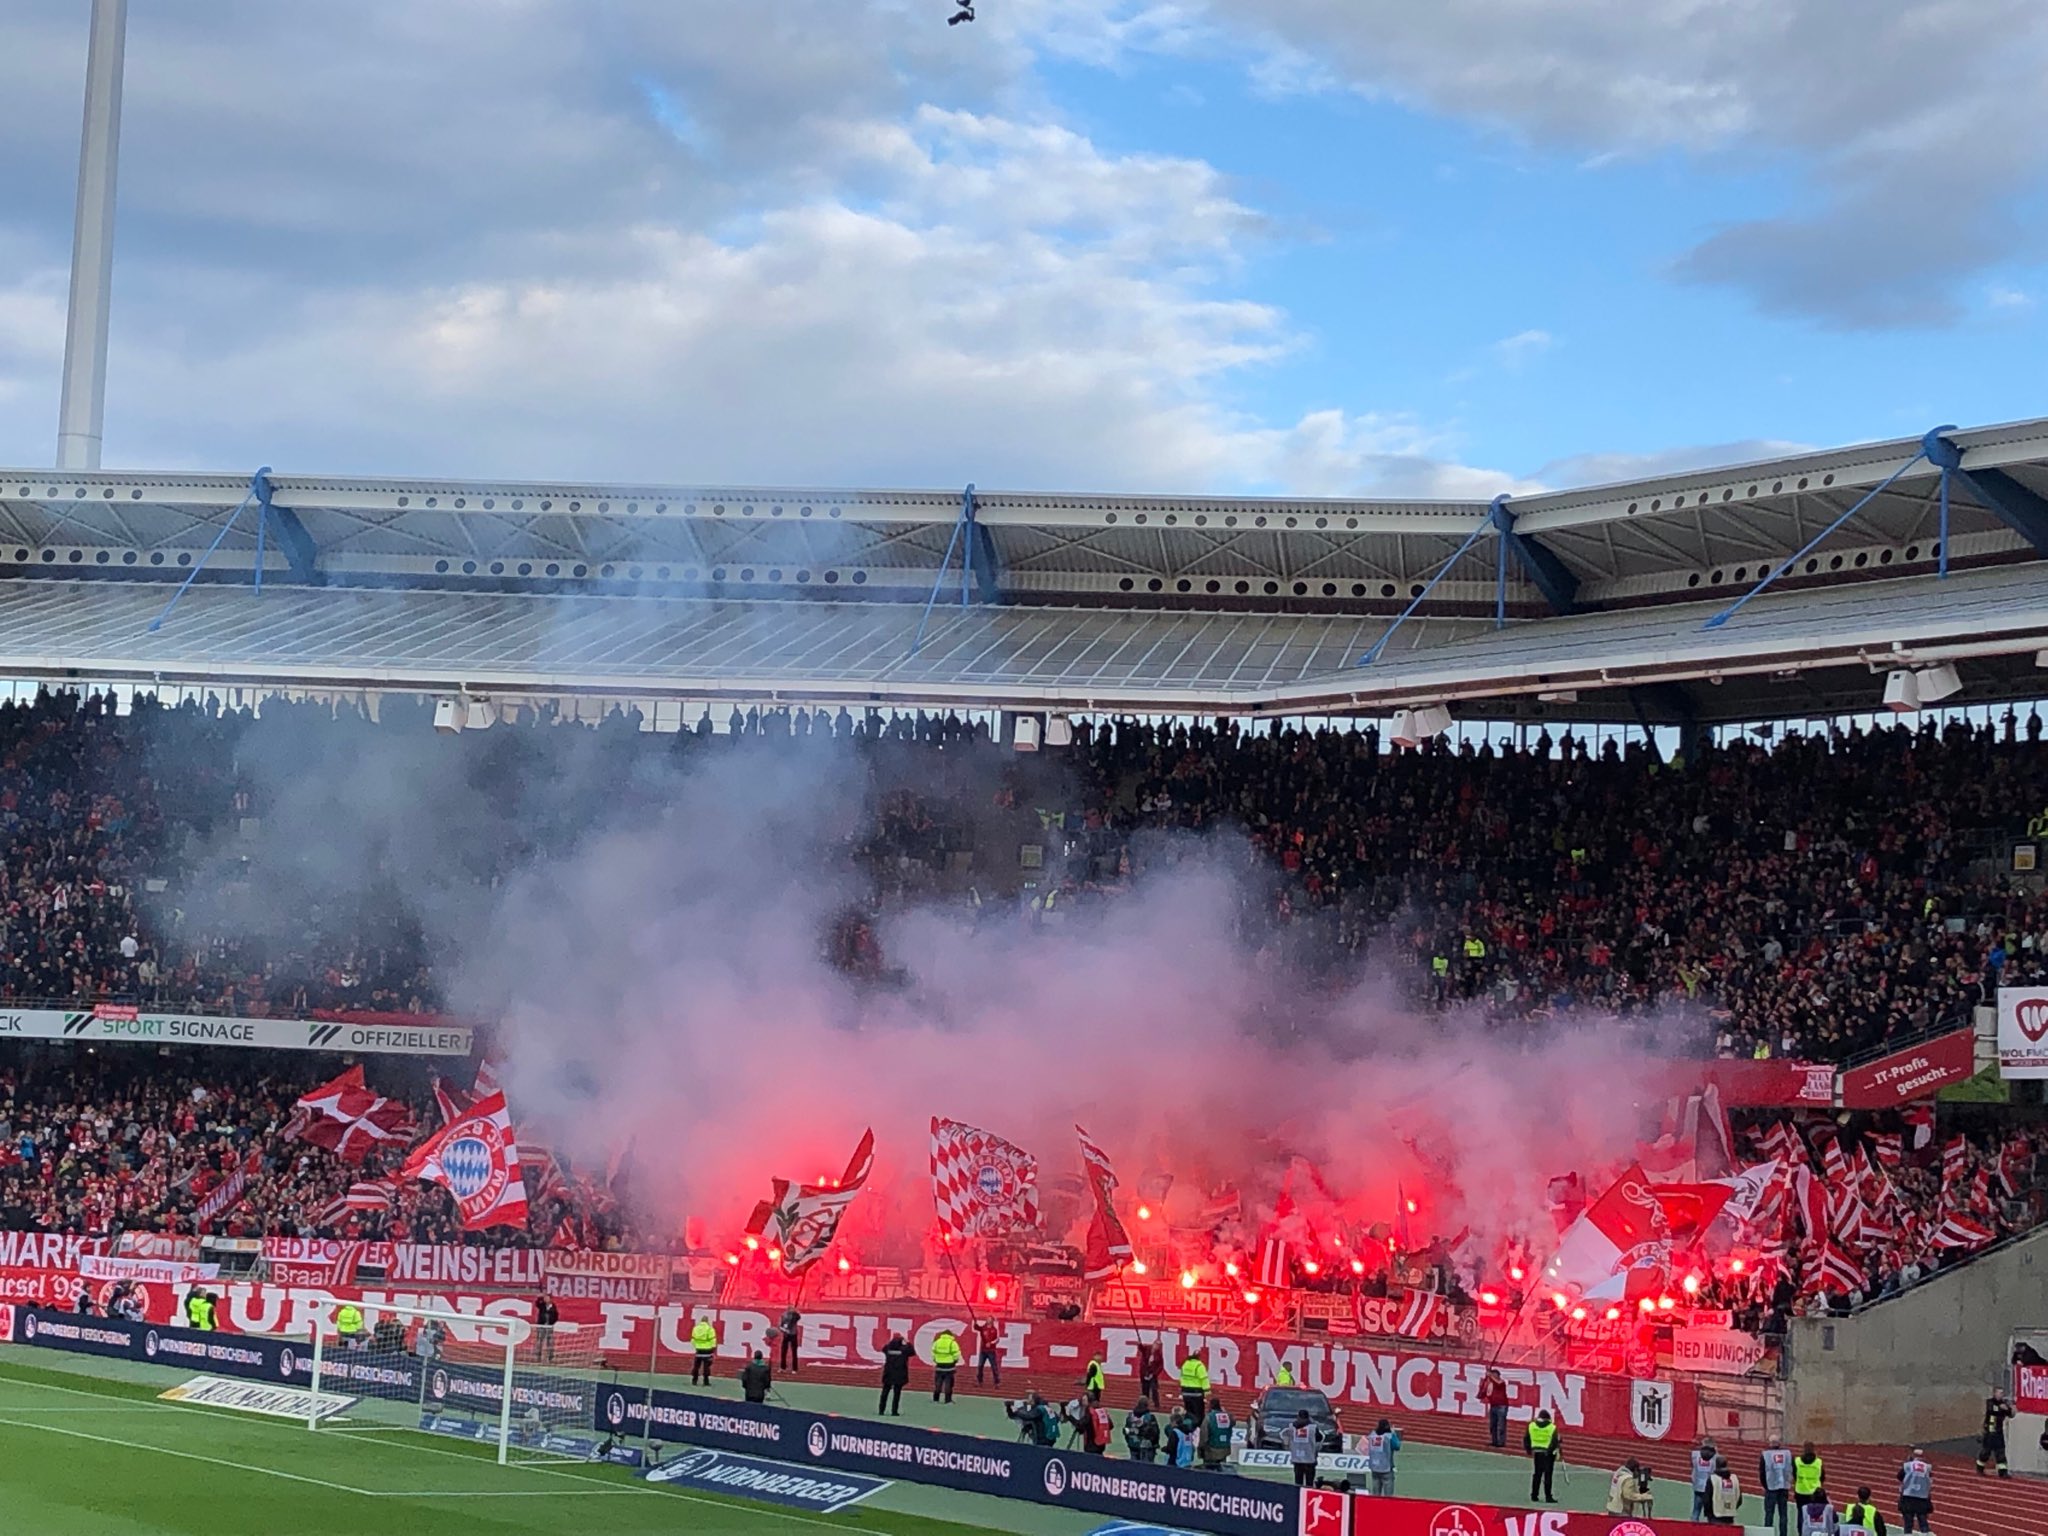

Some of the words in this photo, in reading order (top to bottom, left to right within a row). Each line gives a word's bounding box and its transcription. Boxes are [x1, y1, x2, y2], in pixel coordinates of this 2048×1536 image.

[103, 1020, 164, 1035] SPORT
[169, 1021, 254, 1041] SIGNAGE
[351, 1030, 461, 1050] OFFIZIELLER
[1875, 1058, 1929, 1085] IT-Profis
[1896, 1067, 1948, 1096] gesucht
[0, 1230, 108, 1269] MARKT
[264, 1239, 305, 1260] RED
[80, 1327, 131, 1347] VERSICHERUNG
[207, 1345, 263, 1366] VERSICHERUNG
[599, 1301, 772, 1359] FÜR
[797, 1312, 1031, 1369] EUCH
[1101, 1327, 1242, 1388] FÜR
[1255, 1340, 1586, 1428] MÜNCHEN
[1676, 1341, 1700, 1358] RED
[1703, 1342, 1761, 1364] MUNICHS
[511, 1386, 583, 1412] VERSICHERUNG
[627, 1402, 697, 1427] NÜRNBERGER
[698, 1411, 780, 1441] VERSICHERUNG
[831, 1432, 912, 1463] NÜRNBERGER
[914, 1446, 1011, 1479] VERSICHERUNG
[698, 1462, 859, 1505] NÜRNBERGER
[1070, 1470, 1166, 1504] NÜRNBERGER
[1169, 1486, 1285, 1523] VERSICHERUNG
